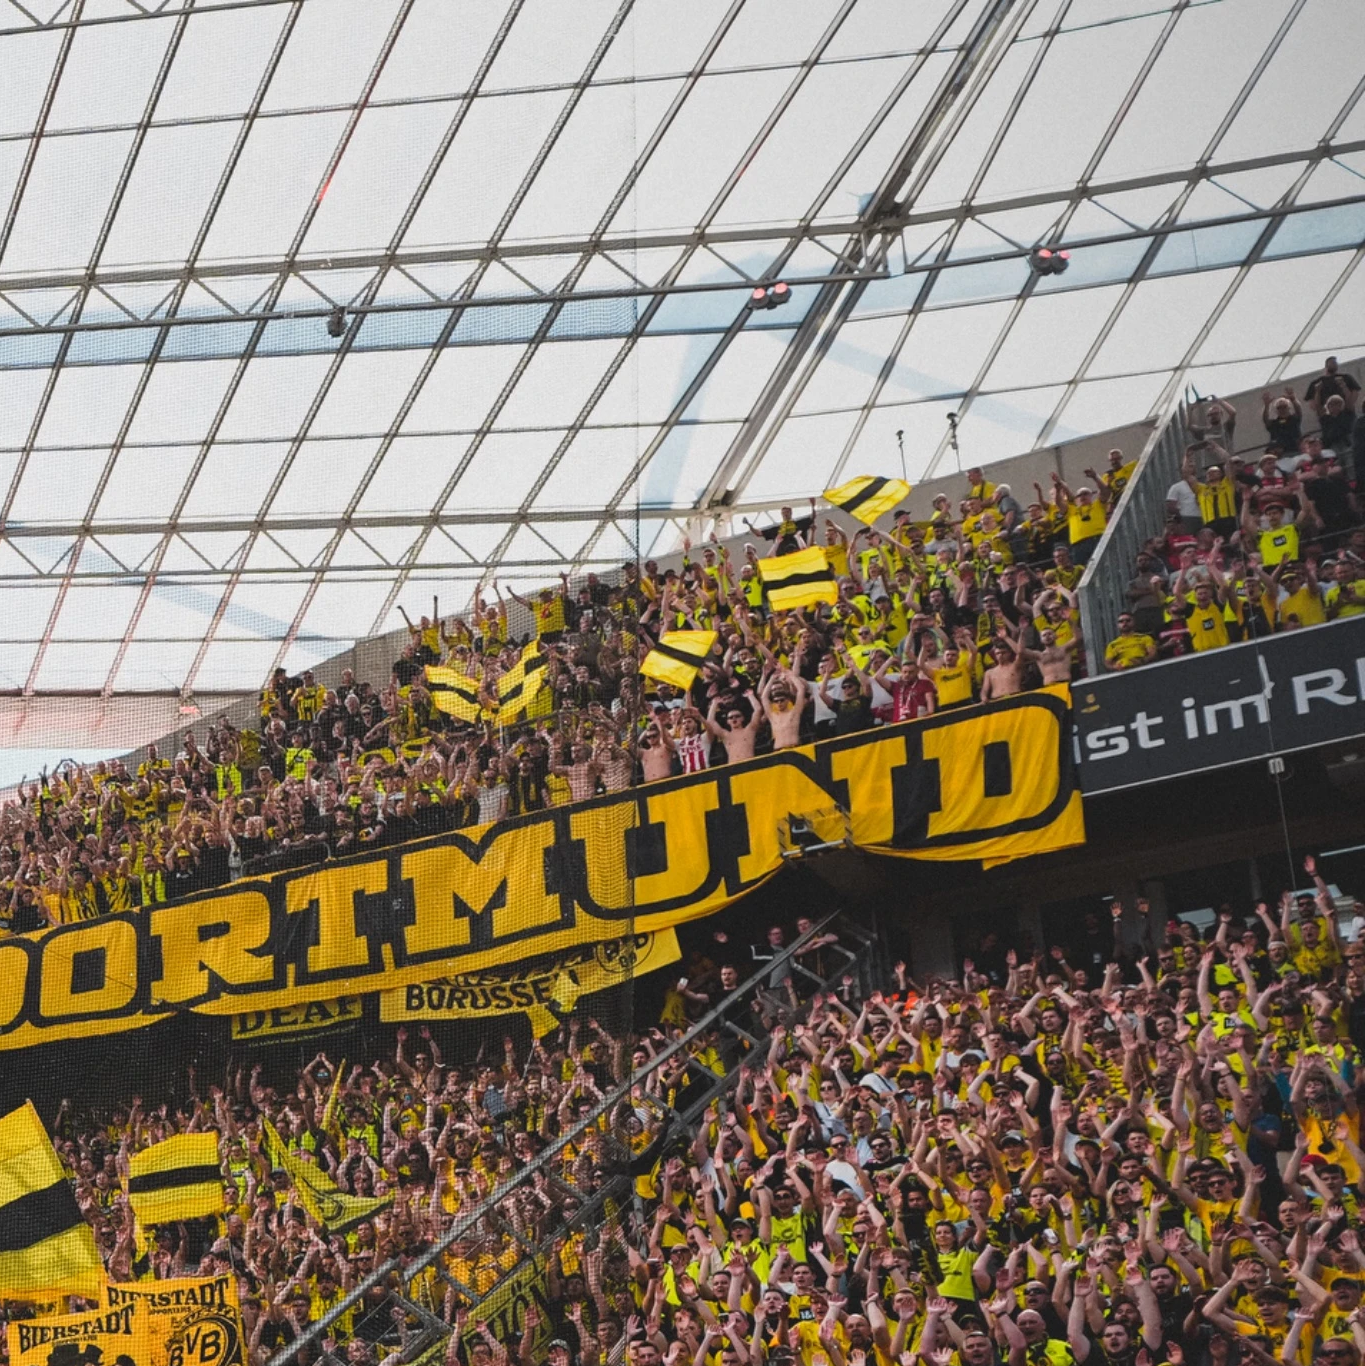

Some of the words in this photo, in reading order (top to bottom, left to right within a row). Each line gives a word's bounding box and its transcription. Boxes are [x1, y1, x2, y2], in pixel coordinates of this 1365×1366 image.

[1072, 711, 1165, 763] ist
[1182, 697, 1269, 740] im
[1291, 657, 1365, 714] R
[406, 975, 556, 1011] BORUSSE
[18, 1304, 135, 1354] BIERSTADT
